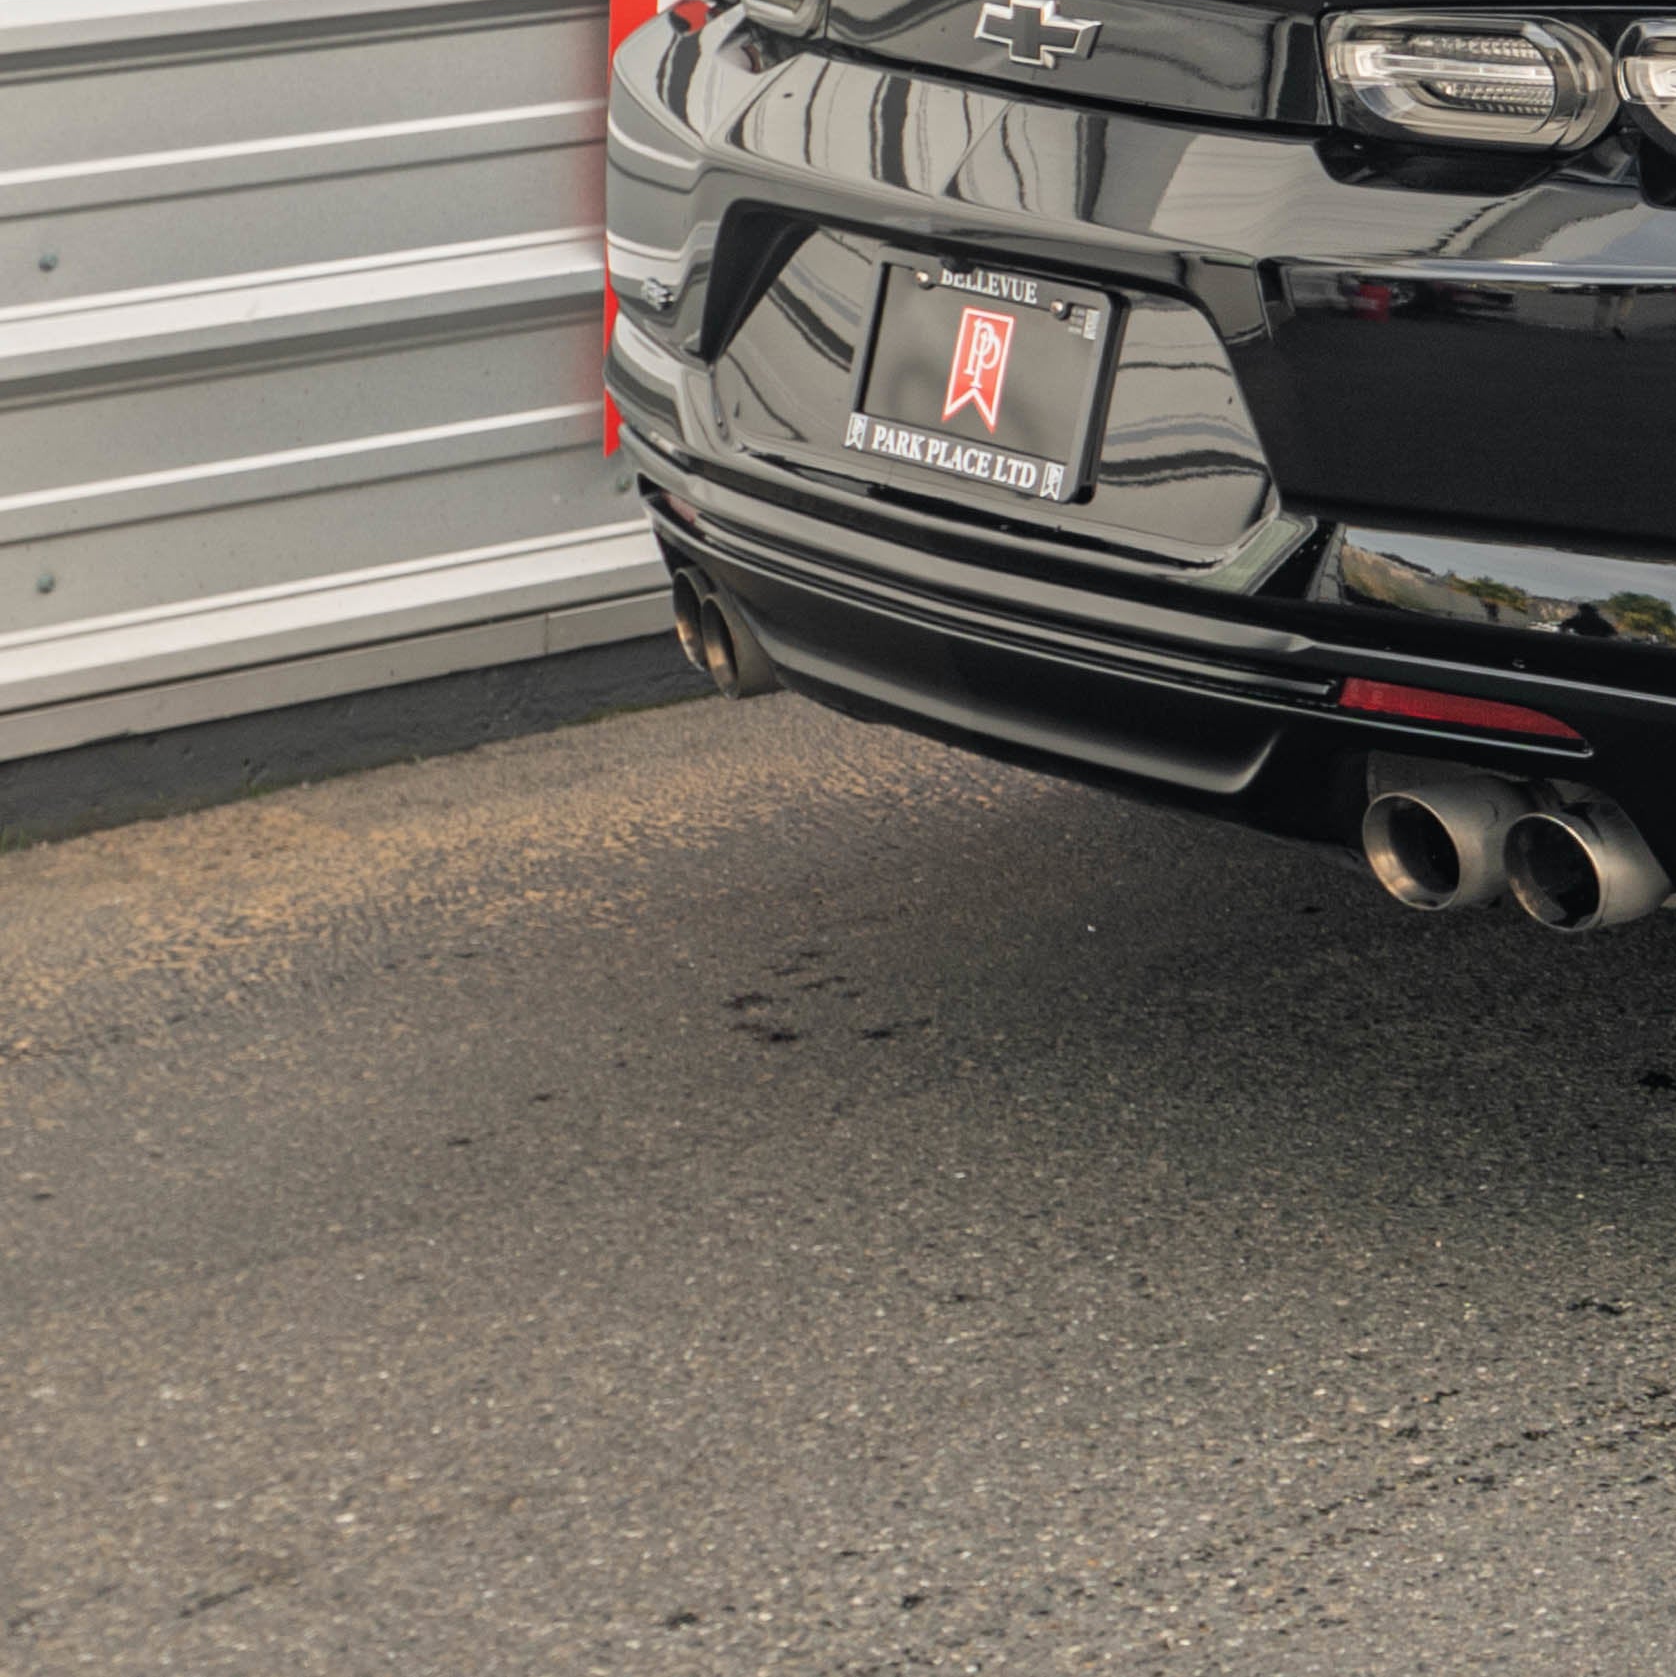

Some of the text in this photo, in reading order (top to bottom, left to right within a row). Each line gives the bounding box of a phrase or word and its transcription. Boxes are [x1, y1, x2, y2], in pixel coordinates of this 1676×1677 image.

[941, 268, 1038, 305] BELLEVUE
[871, 424, 924, 461] PARK
[925, 438, 992, 478] PLACE
[992, 455, 1037, 489] LTD
